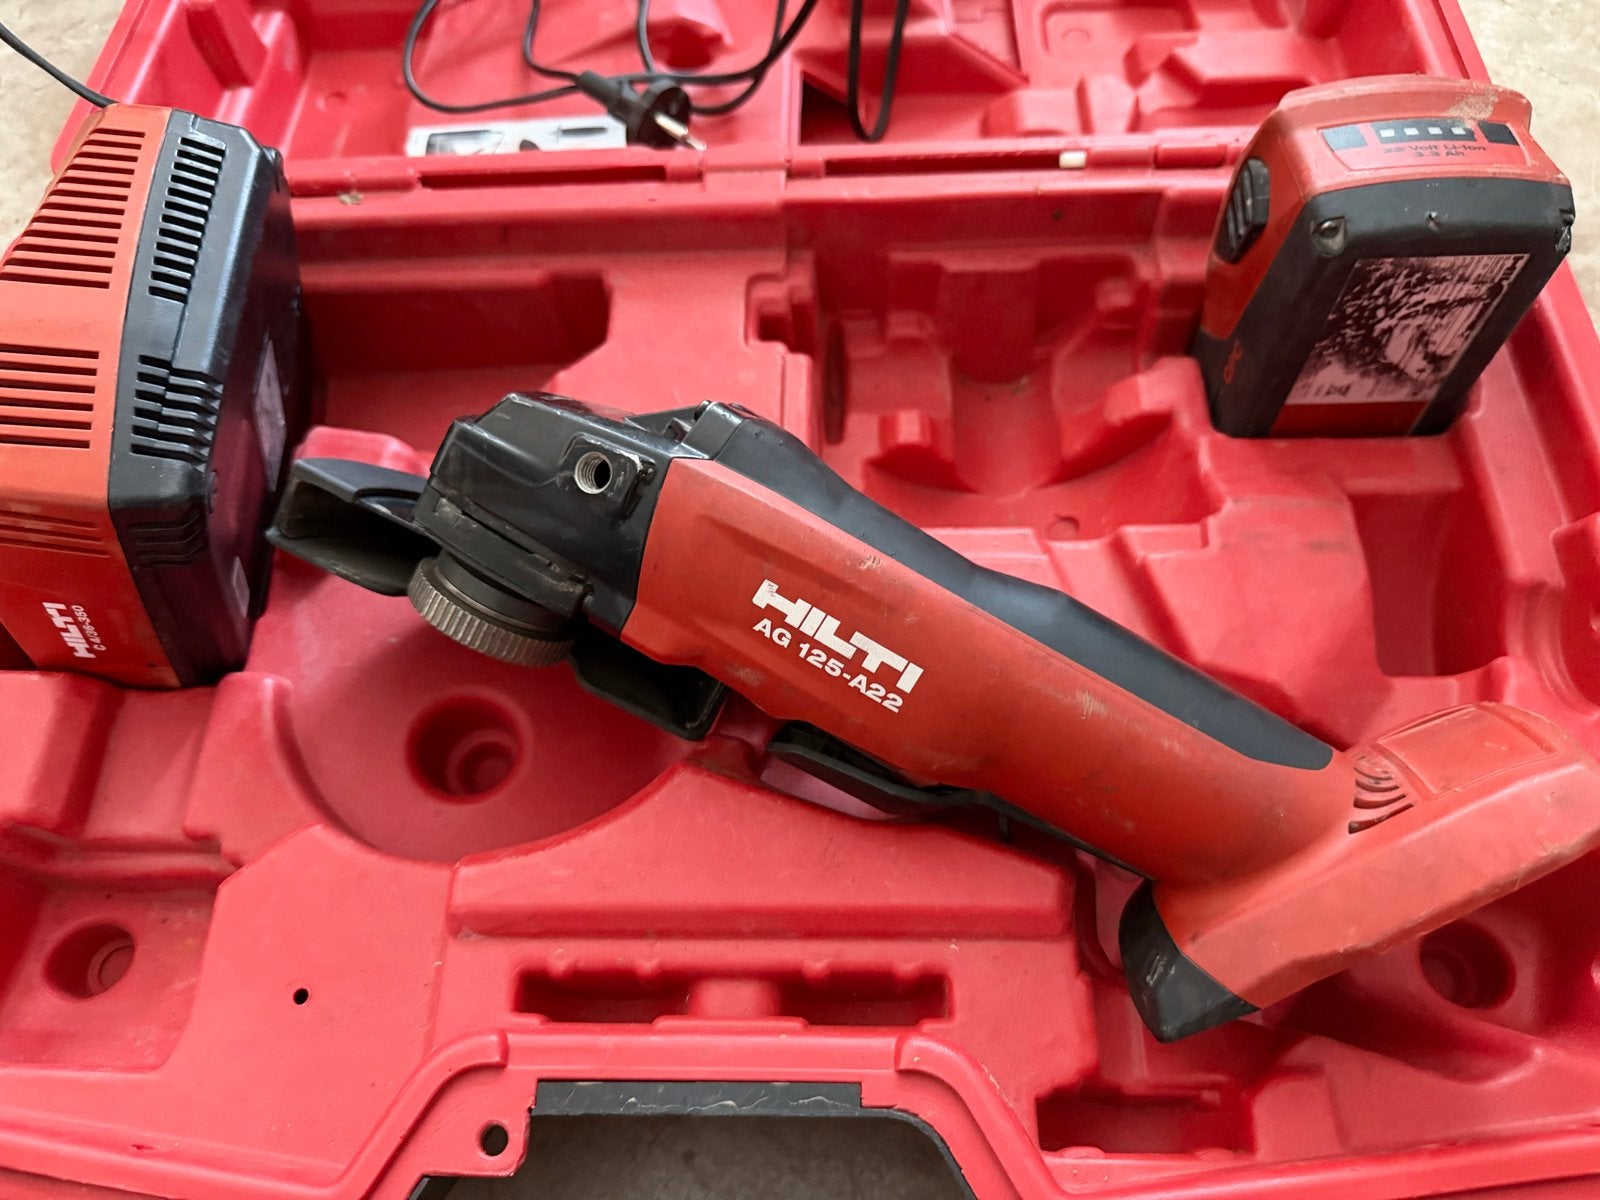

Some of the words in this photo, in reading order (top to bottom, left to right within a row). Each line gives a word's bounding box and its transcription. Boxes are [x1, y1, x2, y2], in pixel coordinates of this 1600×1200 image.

[1408, 143, 1440, 151] Volt
[1415, 150, 1441, 158] 3.3
[42, 602, 97, 659] HILTI
[752, 578, 925, 694] HILTI
[752, 618, 793, 648] AG
[798, 642, 904, 713] 125-A22
